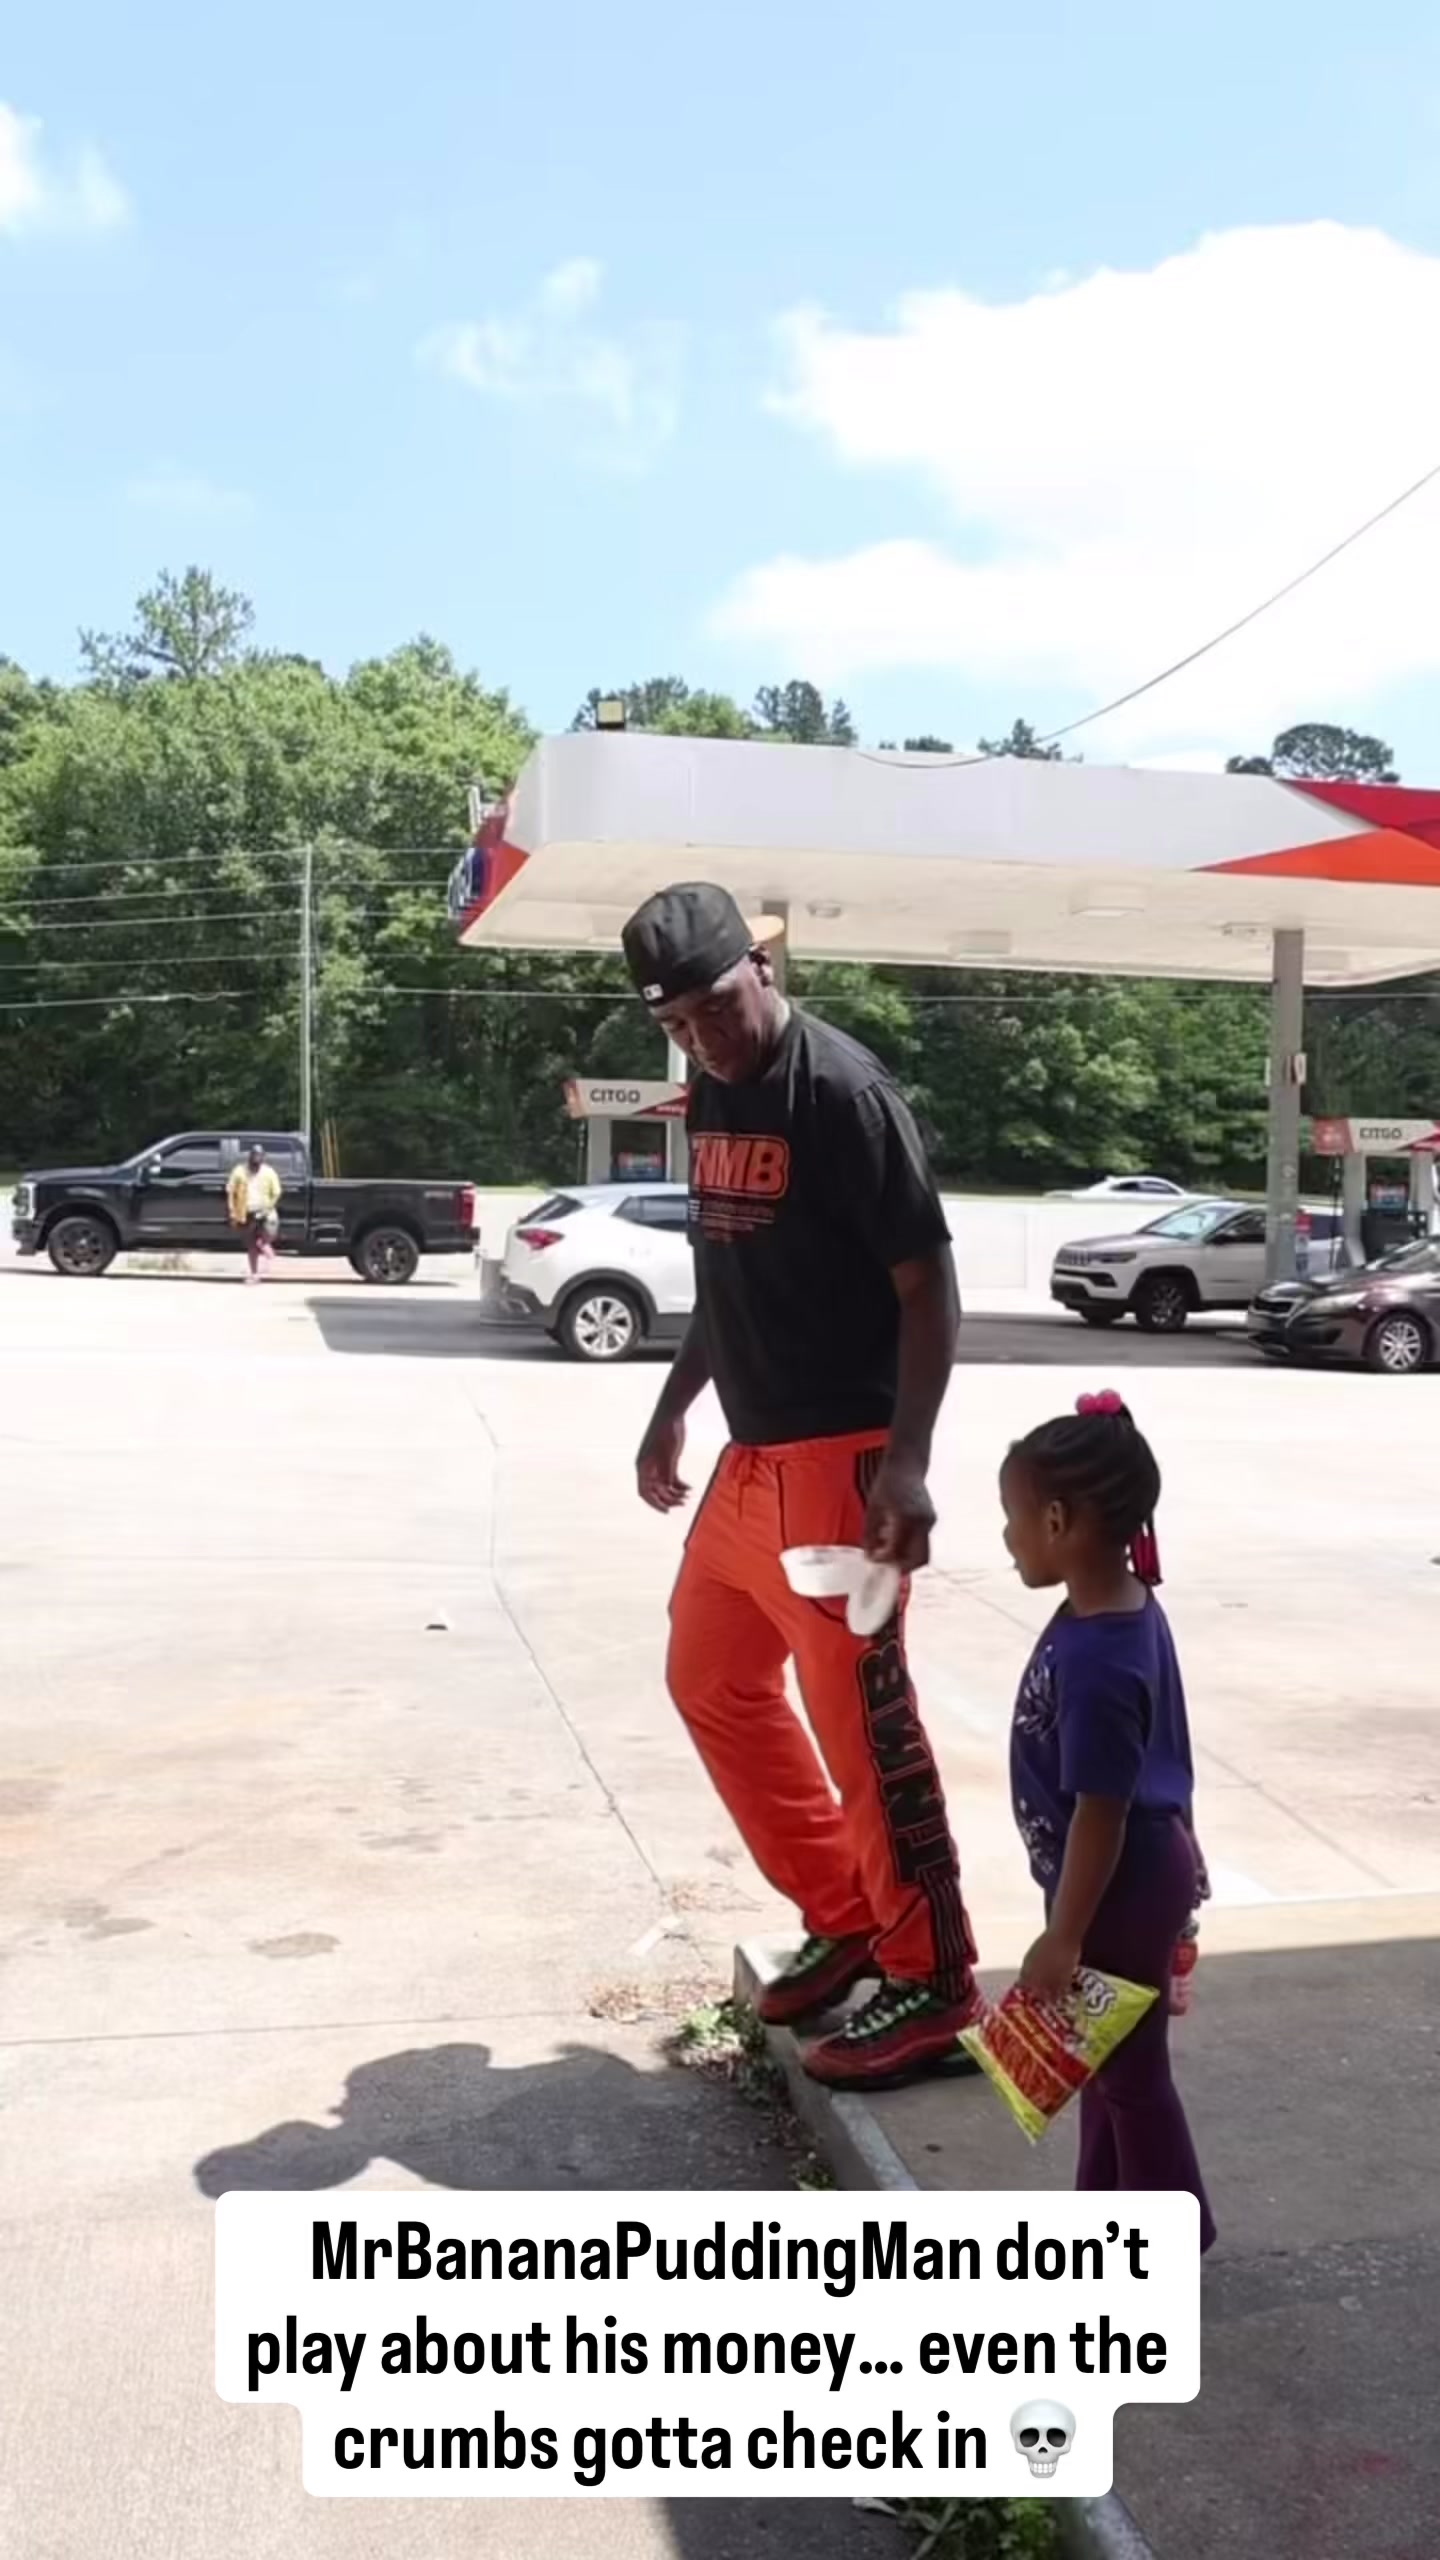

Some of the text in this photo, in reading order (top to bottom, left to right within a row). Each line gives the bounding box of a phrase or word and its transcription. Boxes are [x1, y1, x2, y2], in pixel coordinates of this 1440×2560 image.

[590, 1087, 641, 1104] CITGO
[1360, 1127, 1403, 1139] CITGO
[860, 1640, 954, 1884] TNMB
